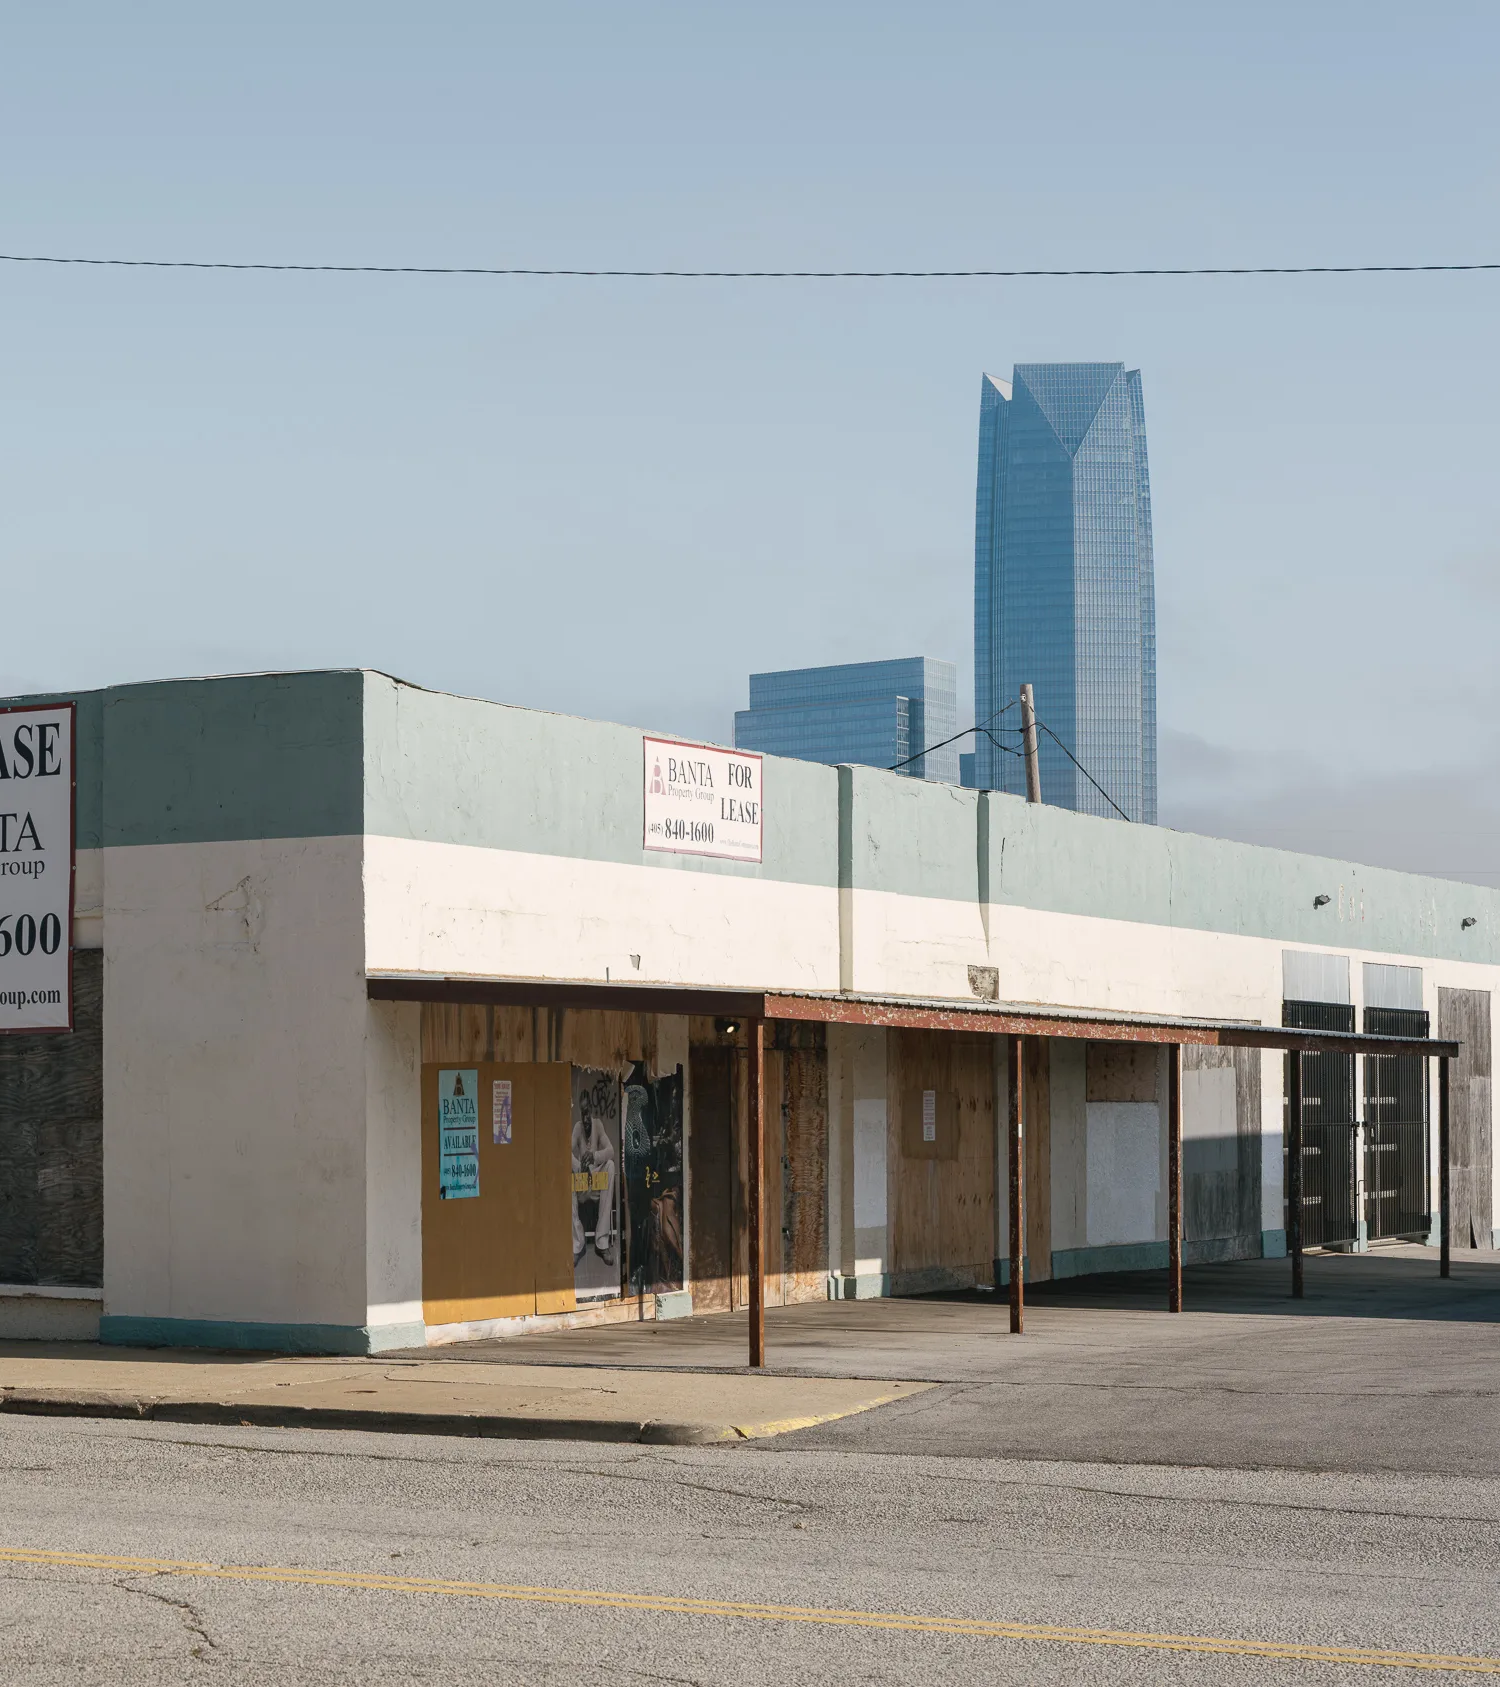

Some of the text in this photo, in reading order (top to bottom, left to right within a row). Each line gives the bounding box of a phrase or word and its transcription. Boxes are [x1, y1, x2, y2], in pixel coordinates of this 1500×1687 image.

[668, 757, 714, 787] BANTA
[728, 762, 752, 789] FOR
[668, 784, 714, 804] Property Group
[720, 797, 759, 825] LEASE
[648, 823, 664, 835] (405)
[665, 817, 714, 844] 840-1600
[442, 1098, 475, 1115] BANTA
[451, 1164, 476, 1178] 840-1600
